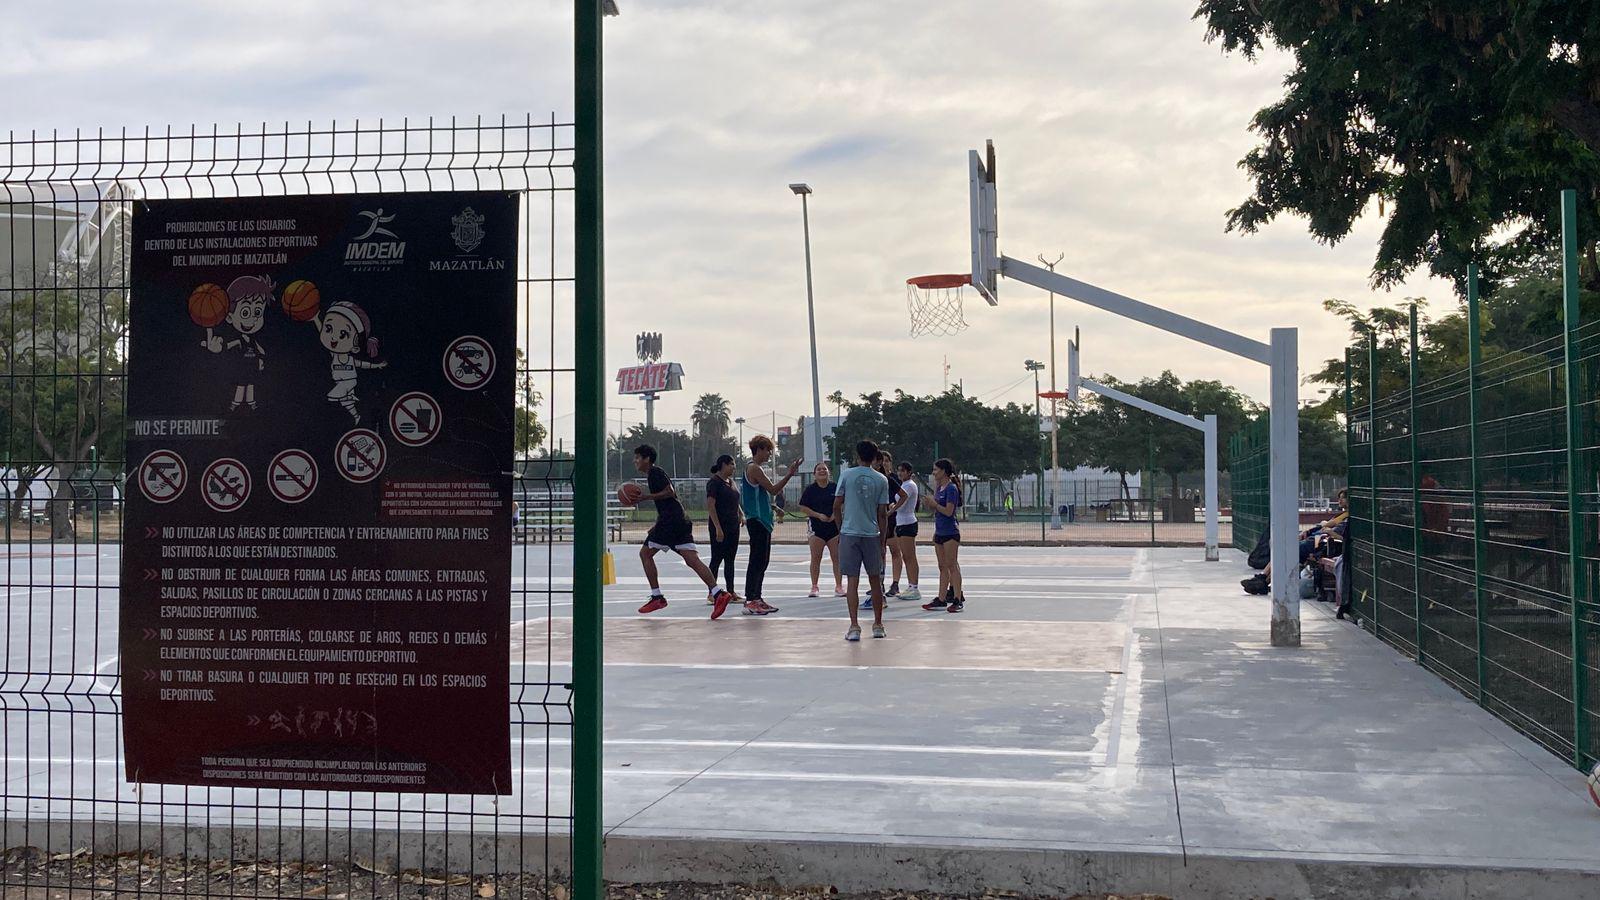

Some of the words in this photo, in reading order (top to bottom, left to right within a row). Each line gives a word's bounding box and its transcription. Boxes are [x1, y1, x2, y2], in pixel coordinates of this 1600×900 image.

[166, 221, 225, 233] PROHIBICIONES
[228, 221, 238, 231] DE
[240, 220, 254, 231] LOS
[256, 219, 296, 230] USUARIOS
[144, 239, 175, 250] DENTRO
[177, 239, 187, 250] DE
[189, 238, 204, 250] LAS
[206, 237, 267, 248] INSTALACIONES
[269, 236, 318, 248] DEPORTIVAS
[345, 242, 406, 260] IMDEM
[172, 256, 186, 266] DEL
[190, 254, 230, 266] MUNICIPIO
[232, 254, 242, 265] DE
[244, 252, 288, 265] MAZATLÁN
[430, 258, 504, 270] MAZATLÁN
[618, 364, 668, 392] TECATE
[135, 420, 150, 435] NO
[153, 420, 166, 435] SE
[170, 420, 219, 435] PERMITE
[162, 527, 174, 539] NO
[177, 527, 216, 539] UTILIZAR
[219, 527, 235, 539] LAS
[238, 525, 266, 539] ÁREAS
[269, 527, 280, 539] DE
[283, 527, 345, 540] COMPETENCIA
[348, 528, 354, 540] Y
[357, 528, 433, 540] ENTRENAMIENTO
[436, 528, 460, 540] PARA
[463, 528, 489, 540] FINES
[162, 546, 207, 558] DISTINTOS
[208, 546, 213, 558] A
[215, 546, 232, 558] LOS
[233, 546, 250, 558] QUE
[252, 544, 279, 558] ESTÁN
[280, 546, 338, 558] DESTINADOS.
[162, 568, 173, 580] NO
[178, 569, 220, 580] OBSTRUIR
[225, 569, 236, 580] DE
[242, 569, 290, 581] CUALQUIER
[295, 569, 325, 581] FORMA
[330, 570, 346, 581] LAS
[351, 567, 380, 581] ÁREAS
[386, 570, 432, 583] COMUNES,
[437, 570, 488, 584] ENTRADAS,
[161, 587, 199, 600] SALIDAS,
[203, 587, 244, 600] PASILLOS
[247, 588, 258, 600] DE
[262, 586, 320, 600] CIRCULACIÓN
[323, 588, 329, 600] O
[332, 589, 362, 600] ZONAS
[365, 589, 413, 601] CERCANAS
[417, 589, 422, 601] A
[426, 589, 443, 601] LAS
[447, 590, 478, 602] PISTAS
[482, 590, 488, 602] Y
[160, 606, 202, 618] ESPACIOS
[203, 606, 259, 618] DEPORTIVOS.
[160, 628, 172, 640] NO
[177, 629, 214, 640] SUBIRSE
[219, 629, 225, 640] A
[230, 629, 247, 641] LAS
[251, 627, 304, 643] PORTERÍAS,
[309, 630, 355, 642] COLGARSE
[360, 631, 371, 642] DE
[376, 631, 404, 645] AROS,
[409, 632, 438, 644] REDES
[443, 632, 449, 644] O
[454, 630, 487, 645] DEMÁS
[160, 647, 211, 659] ELEMENTOS
[213, 648, 230, 661] QUE
[231, 648, 286, 660] CONFORMEN
[287, 649, 298, 660] EL
[300, 649, 364, 662] EQUIPAMIENTO
[366, 650, 418, 663] DEPORTIVO.
[160, 670, 172, 682] NO
[177, 670, 203, 682] TIRAR
[208, 671, 244, 683] BASURA
[248, 671, 254, 683] O
[259, 671, 309, 684] CUALQUIER
[314, 672, 334, 685] TIPO
[340, 673, 351, 685] DE
[356, 673, 397, 686] DESECHO
[402, 674, 415, 686] EN
[420, 674, 437, 687] LOS
[442, 675, 487, 688] ESPACIOS
[160, 689, 216, 701] DEPORTIVOS.
[201, 757, 217, 765] TODA
[218, 758, 245, 766] PERSONA
[246, 758, 257, 767] QUE
[260, 759, 270, 767] SEA
[272, 759, 314, 768] SORPRENDIDO
[314, 760, 360, 770] INCUMPLIENDO
[361, 761, 374, 770] CON
[375, 762, 387, 770] LAS
[388, 762, 426, 772] ANTERIORES
[294, 772, 306, 781] CON
[308, 773, 319, 781] LAS
[363, 774, 425, 784] CORRESPONDIENTES
